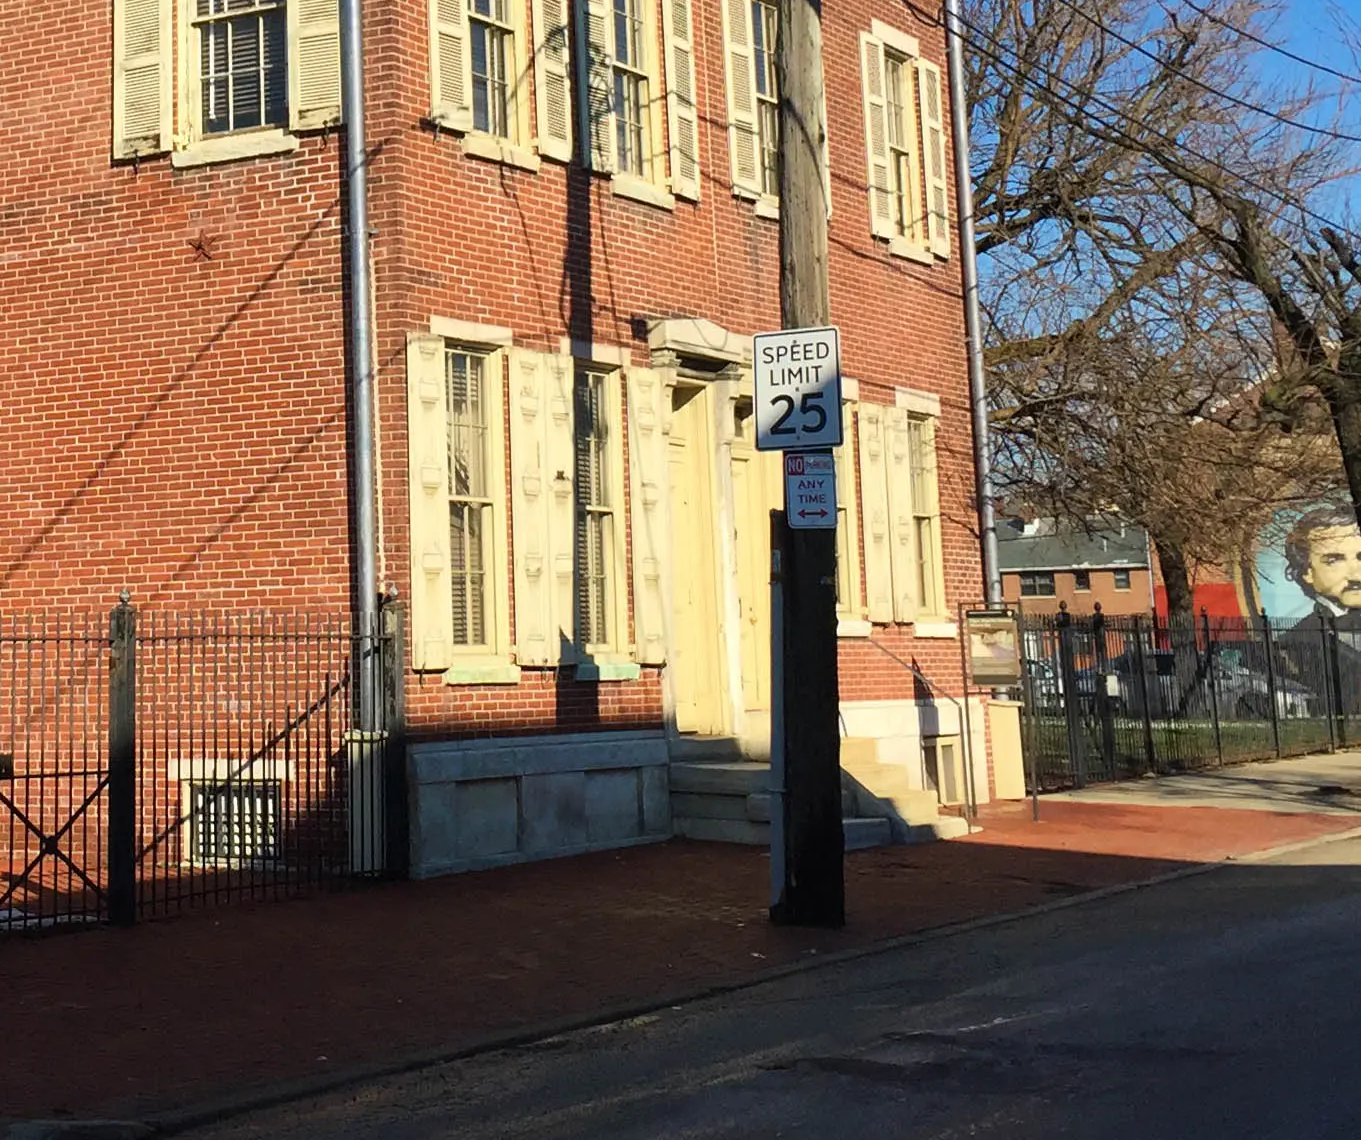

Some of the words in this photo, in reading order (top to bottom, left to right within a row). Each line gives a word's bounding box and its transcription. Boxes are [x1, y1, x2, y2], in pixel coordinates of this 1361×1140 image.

[762, 342, 830, 364] SPEED
[770, 365, 823, 386] LIMIT
[770, 392, 827, 435] 25
[788, 458, 803, 473] NO
[798, 480, 825, 490] ANY
[797, 494, 827, 504] TIME
